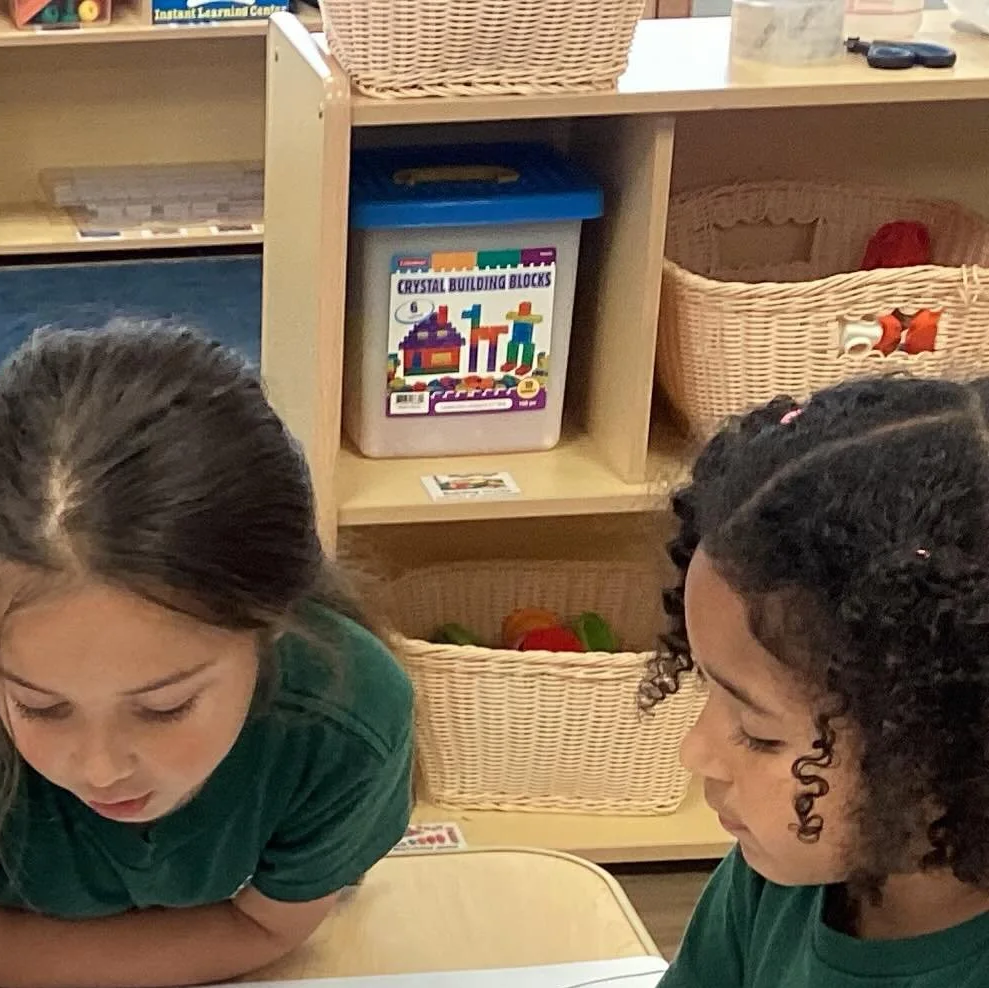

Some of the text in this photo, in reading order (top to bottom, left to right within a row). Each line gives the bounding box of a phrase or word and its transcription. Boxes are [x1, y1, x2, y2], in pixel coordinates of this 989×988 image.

[155, 8, 196, 20] Instant
[197, 5, 248, 18] Learning
[397, 271, 551, 294] CRYSTAL BUILDING BLOCKS
